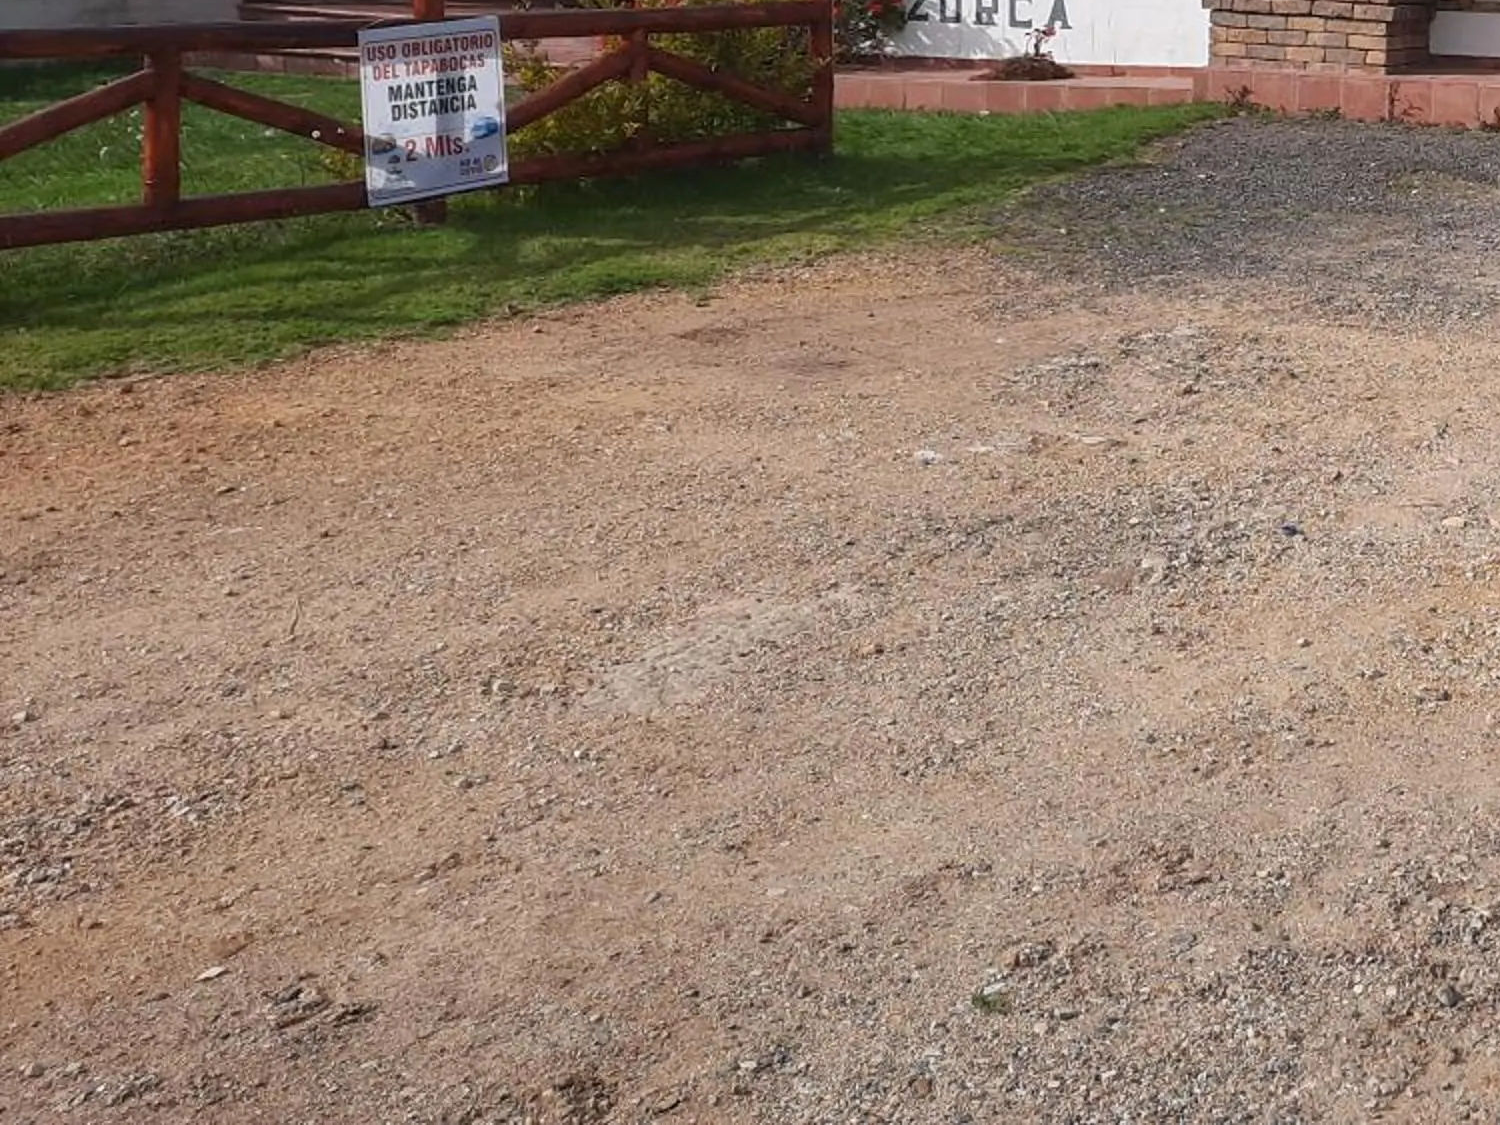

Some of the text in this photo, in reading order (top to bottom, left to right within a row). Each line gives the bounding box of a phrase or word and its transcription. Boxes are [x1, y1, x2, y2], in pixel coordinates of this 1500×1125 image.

[366, 33, 494, 62] USO OBLIGATORIO
[373, 53, 485, 81] DEL TAPABOCAS
[388, 75, 478, 103] MANTENGA
[391, 94, 477, 121] DISTANCIA
[405, 138, 418, 162] 2
